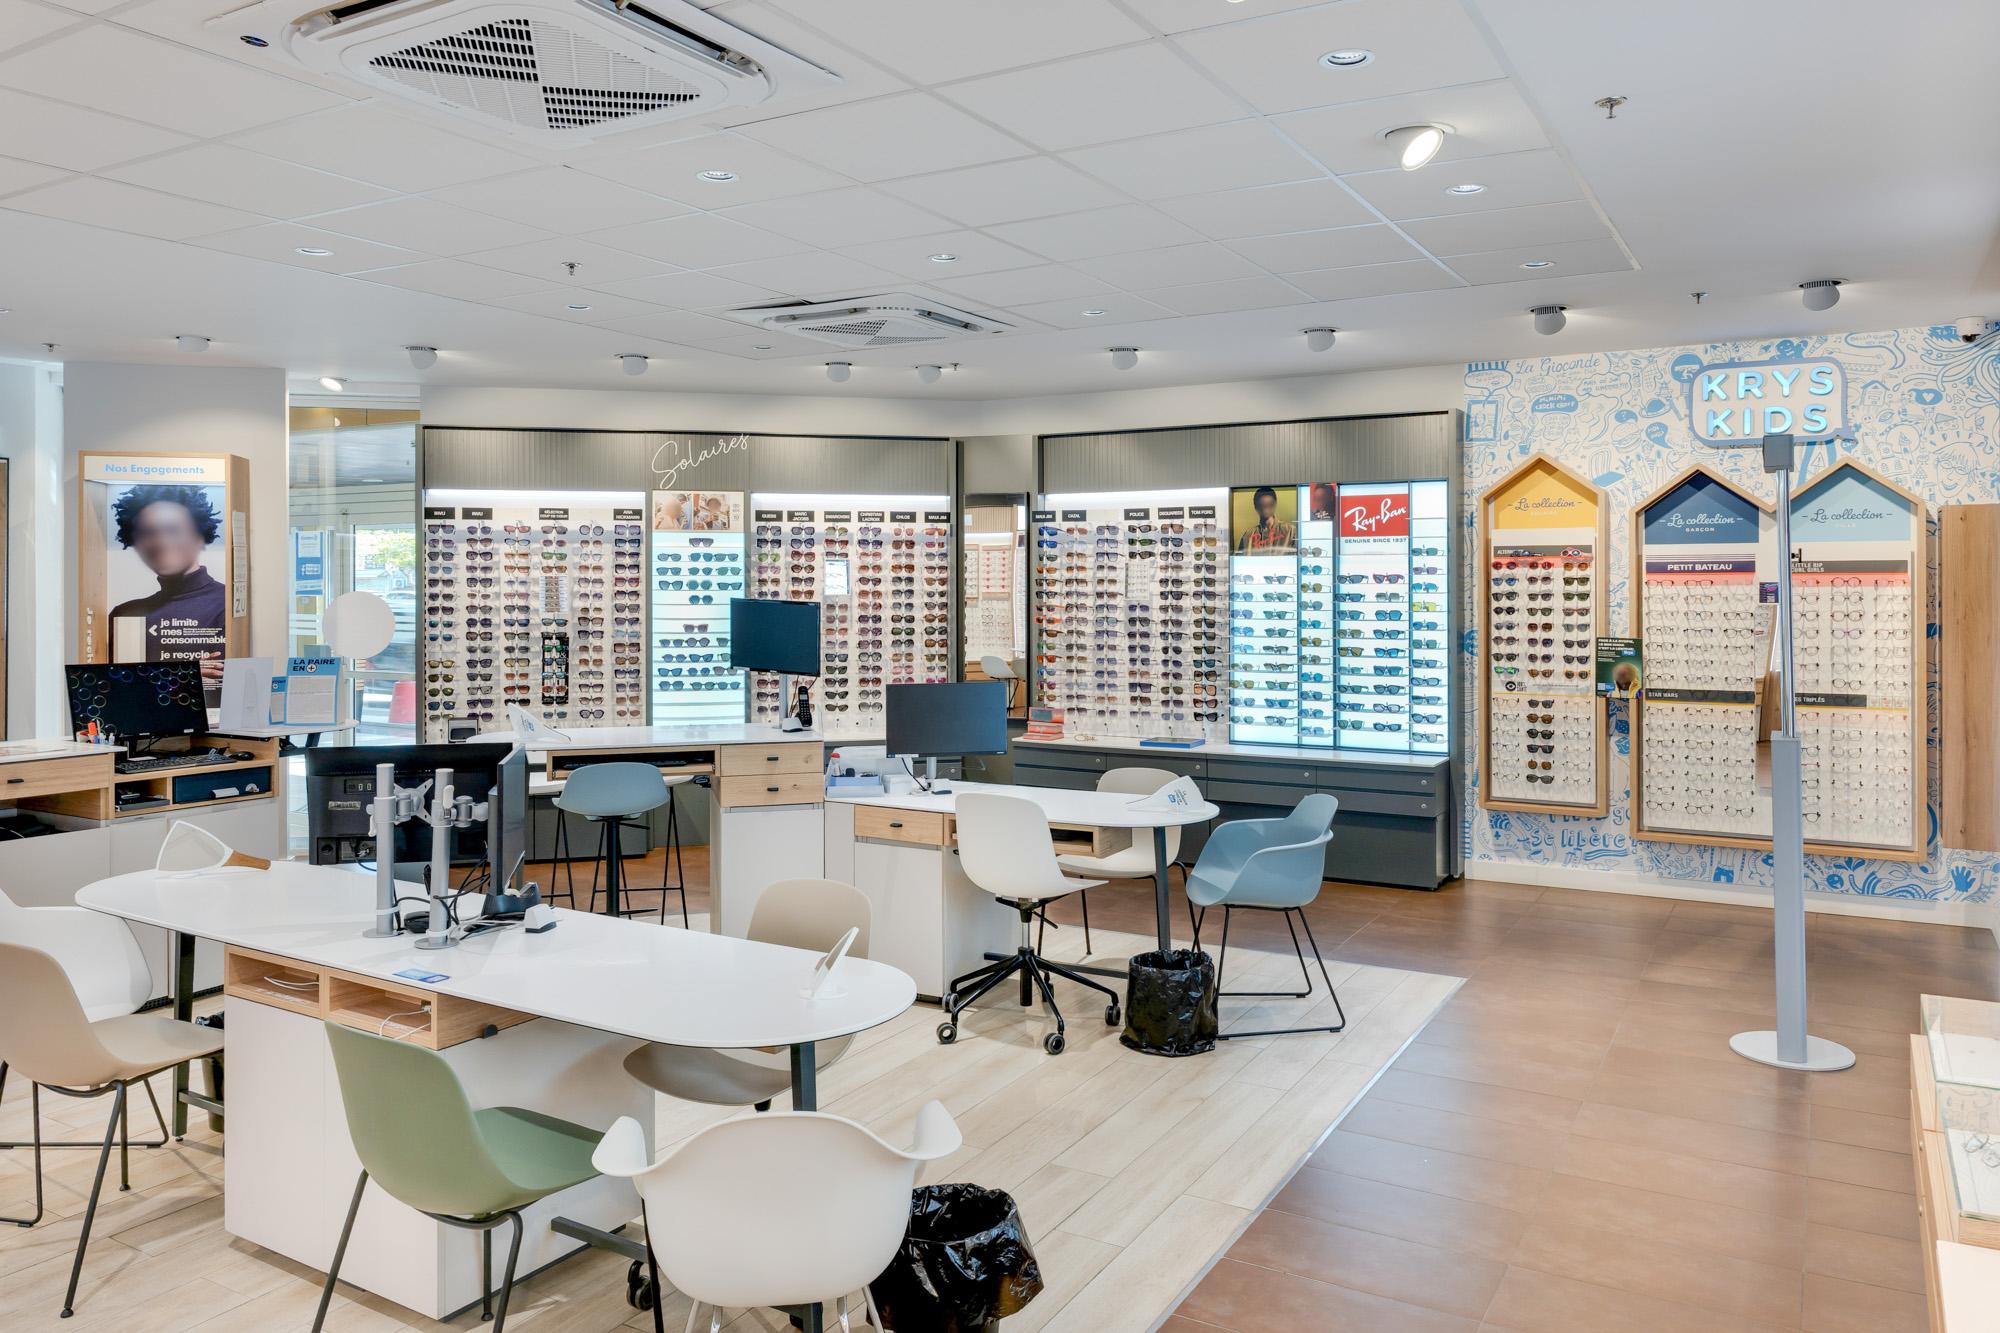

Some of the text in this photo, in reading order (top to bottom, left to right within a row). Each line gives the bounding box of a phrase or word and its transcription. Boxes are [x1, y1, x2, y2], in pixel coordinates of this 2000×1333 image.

[1702, 366, 1834, 401] KRYS
[1707, 404, 1828, 437] KIDS
[652, 433, 751, 489] Solaires
[105, 464, 205, 476] Nos Engagements
[1515, 498, 1576, 512] La collection
[1344, 498, 1406, 532] Ray-Ban
[1668, 514, 1735, 528] La collection
[1810, 508, 1884, 524] La collection
[160, 618, 198, 628] je limite
[160, 650, 210, 660] je recycle
[1531, 826, 1626, 848] Se libère
